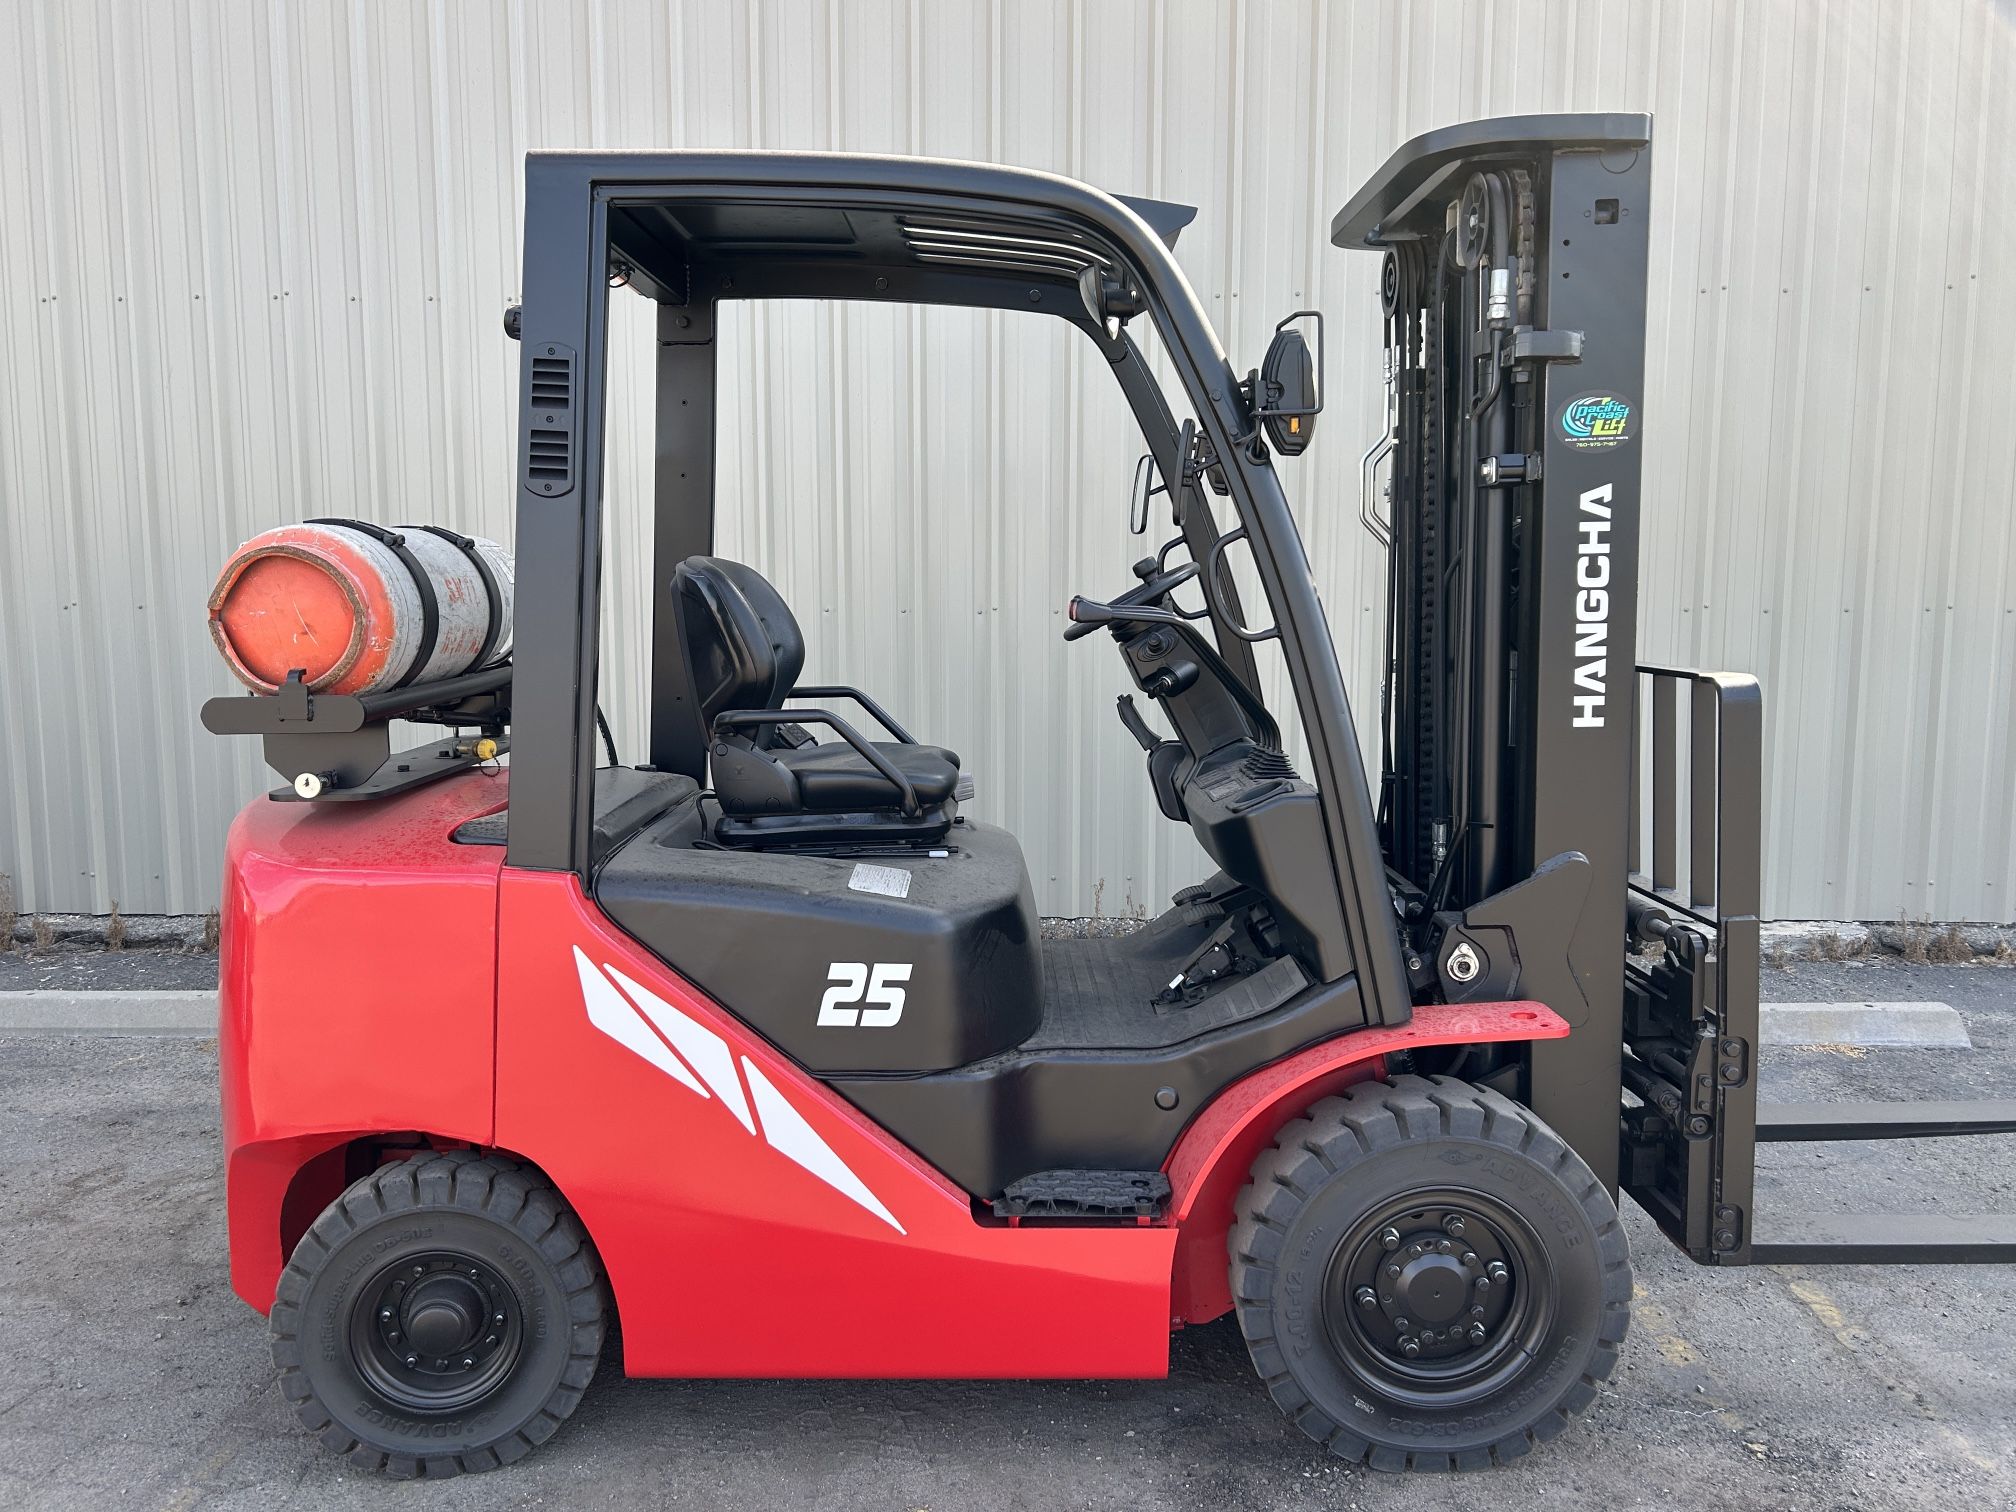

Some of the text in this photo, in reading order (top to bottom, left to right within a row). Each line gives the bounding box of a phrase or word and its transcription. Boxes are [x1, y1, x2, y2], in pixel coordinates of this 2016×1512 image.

[1585, 407, 1630, 425] Coast
[1592, 418, 1626, 436] Lift
[1572, 482, 1613, 728] HANGCHA
[816, 962, 913, 1027] 25
[1481, 1158, 1584, 1249] ADVANCE
[353, 1400, 463, 1438] ADVANCE
